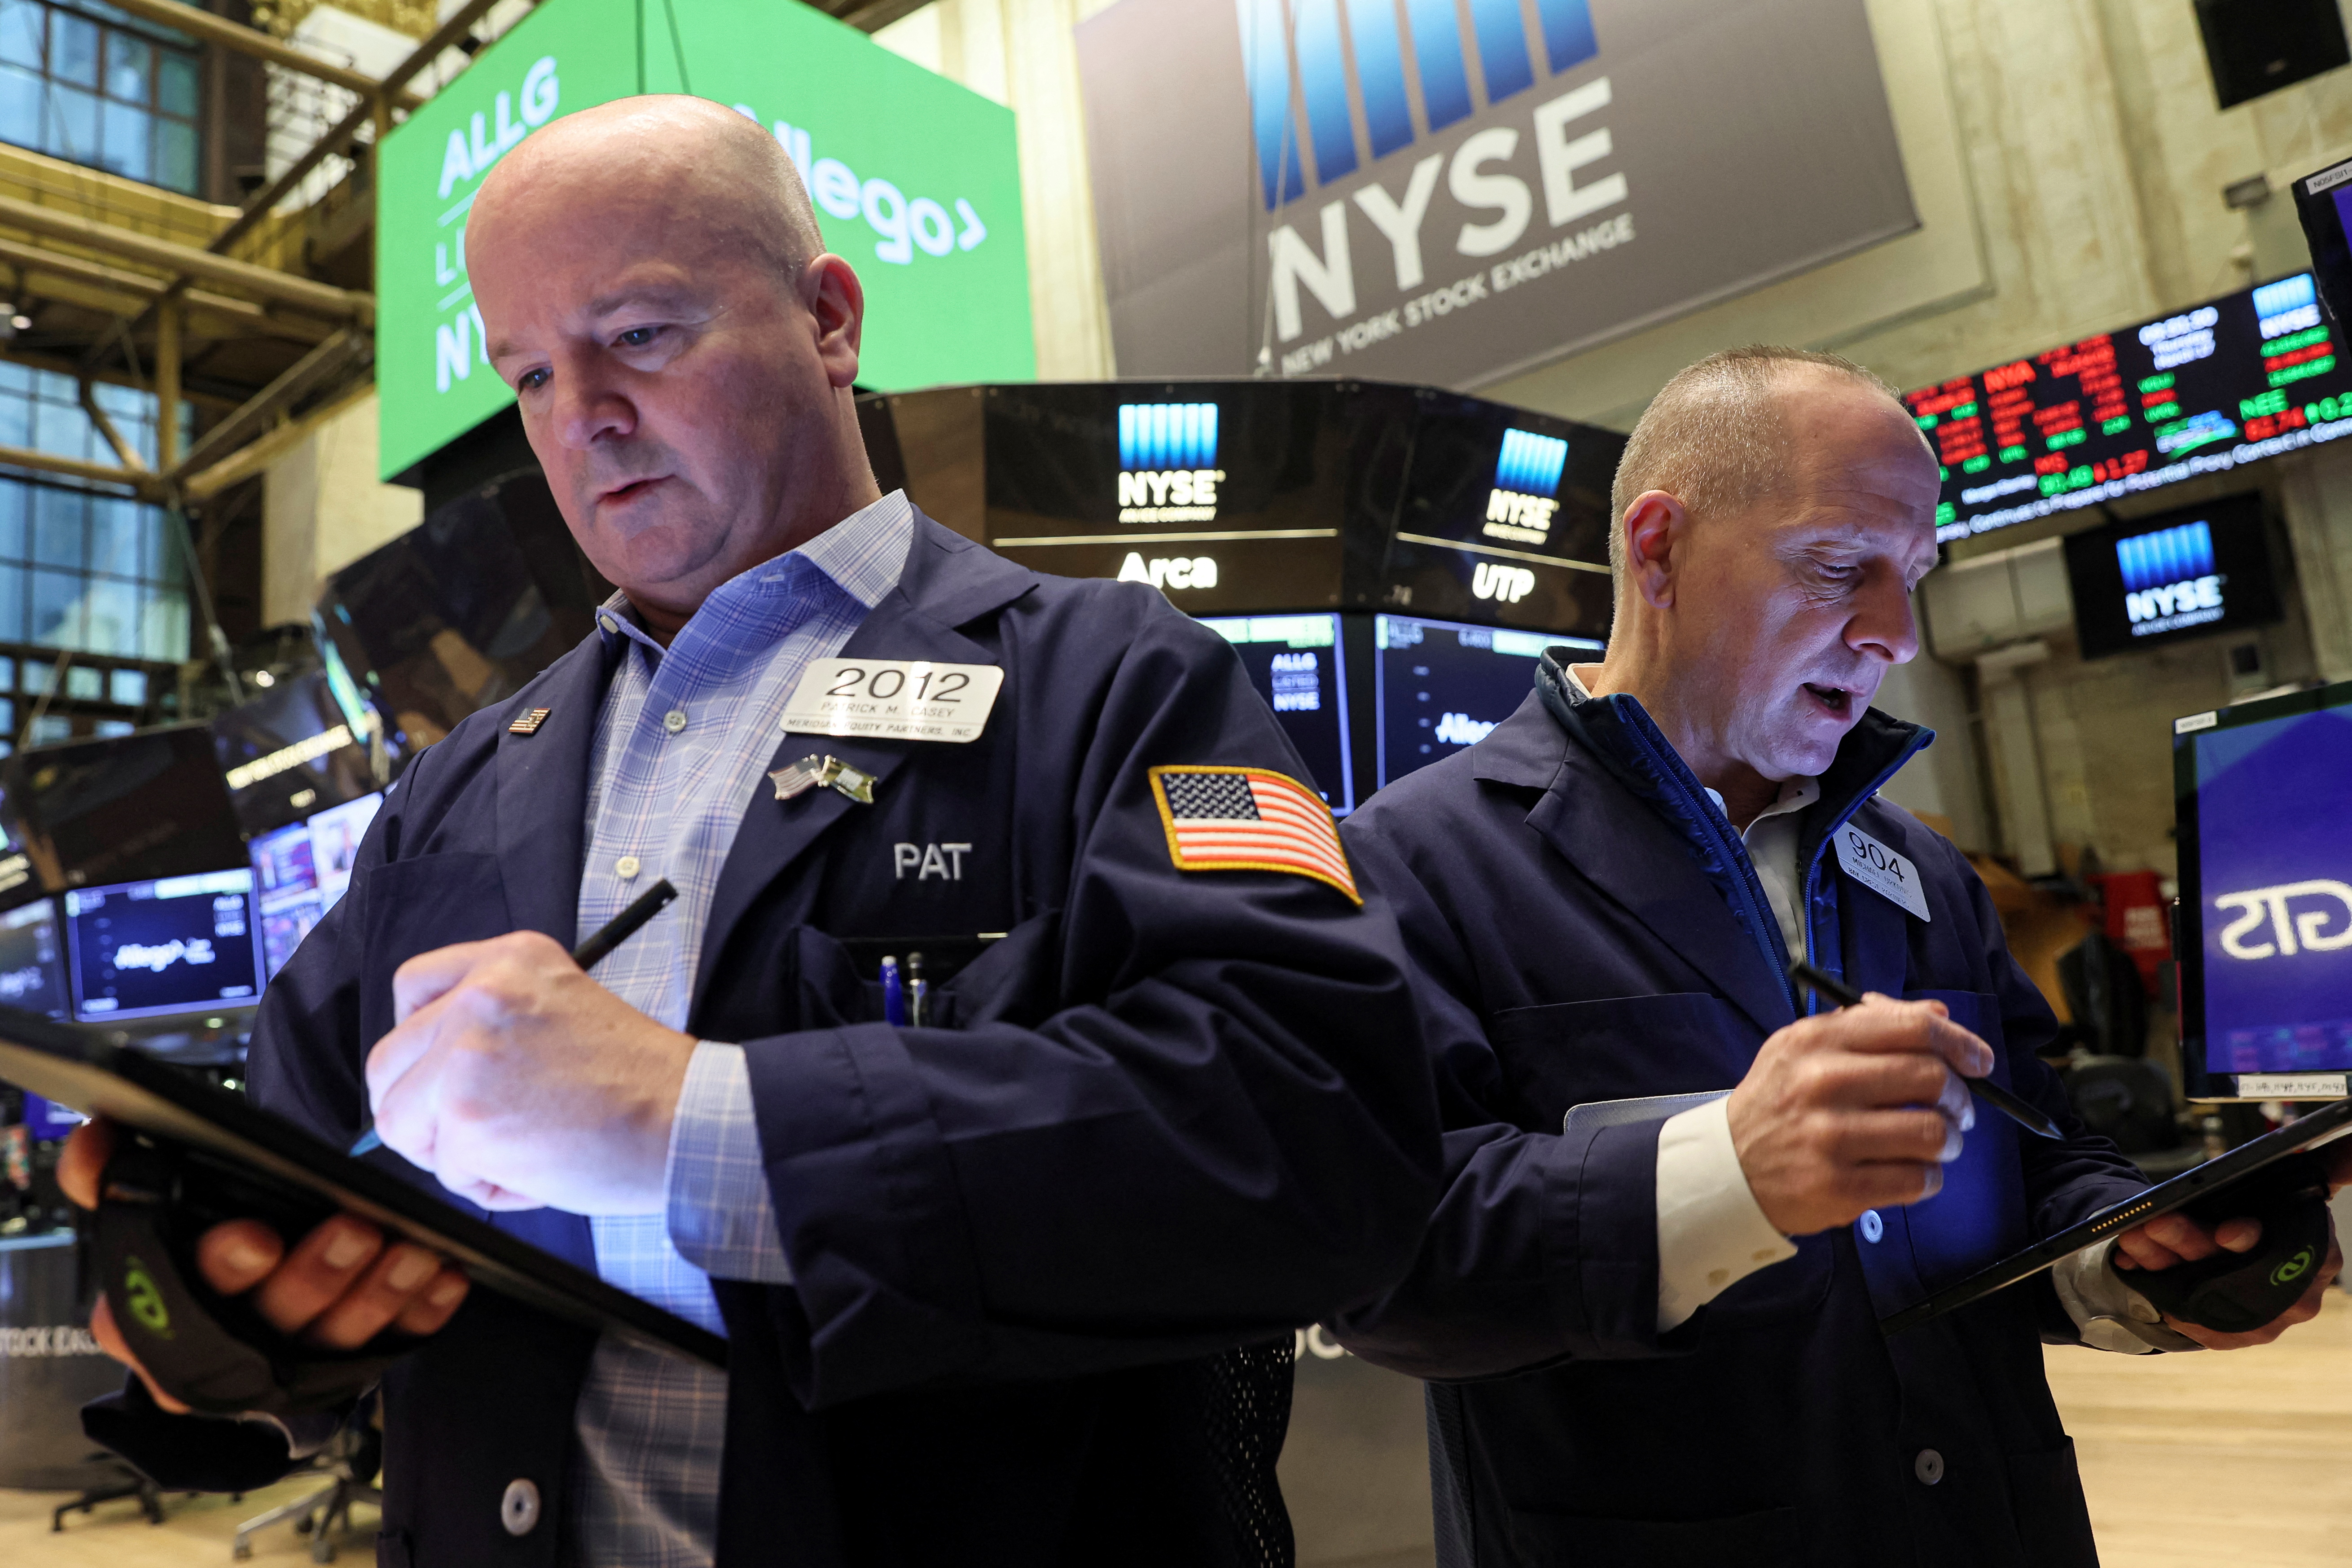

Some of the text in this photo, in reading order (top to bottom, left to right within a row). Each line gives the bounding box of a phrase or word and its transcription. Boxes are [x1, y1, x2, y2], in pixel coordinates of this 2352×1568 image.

[438, 56, 560, 200] ALLG
[1267, 75, 1628, 343] NYSE
[1281, 213, 1636, 377] NEW YORK STOCK EXCHANGE
[1118, 470, 1218, 506] NYSE
[1486, 488, 1556, 531] NYSE
[1116, 552, 1217, 589] Arca
[1472, 562, 1535, 603] UTP
[2125, 575, 2224, 623] NYSE
[1270, 652, 1318, 671] ALLG
[825, 668, 970, 702] 2012
[1273, 692, 1321, 712] NYSE
[786, 718, 837, 728] MERIDIAN
[844, 721, 882, 731] EQUITY
[821, 701, 878, 714] PATRICK
[911, 707, 956, 718] CASEY
[894, 843, 973, 881] PAT
[1848, 831, 1905, 883] 904
[1848, 867, 1859, 878] BAY
[1852, 856, 1881, 878] MICHAEL
